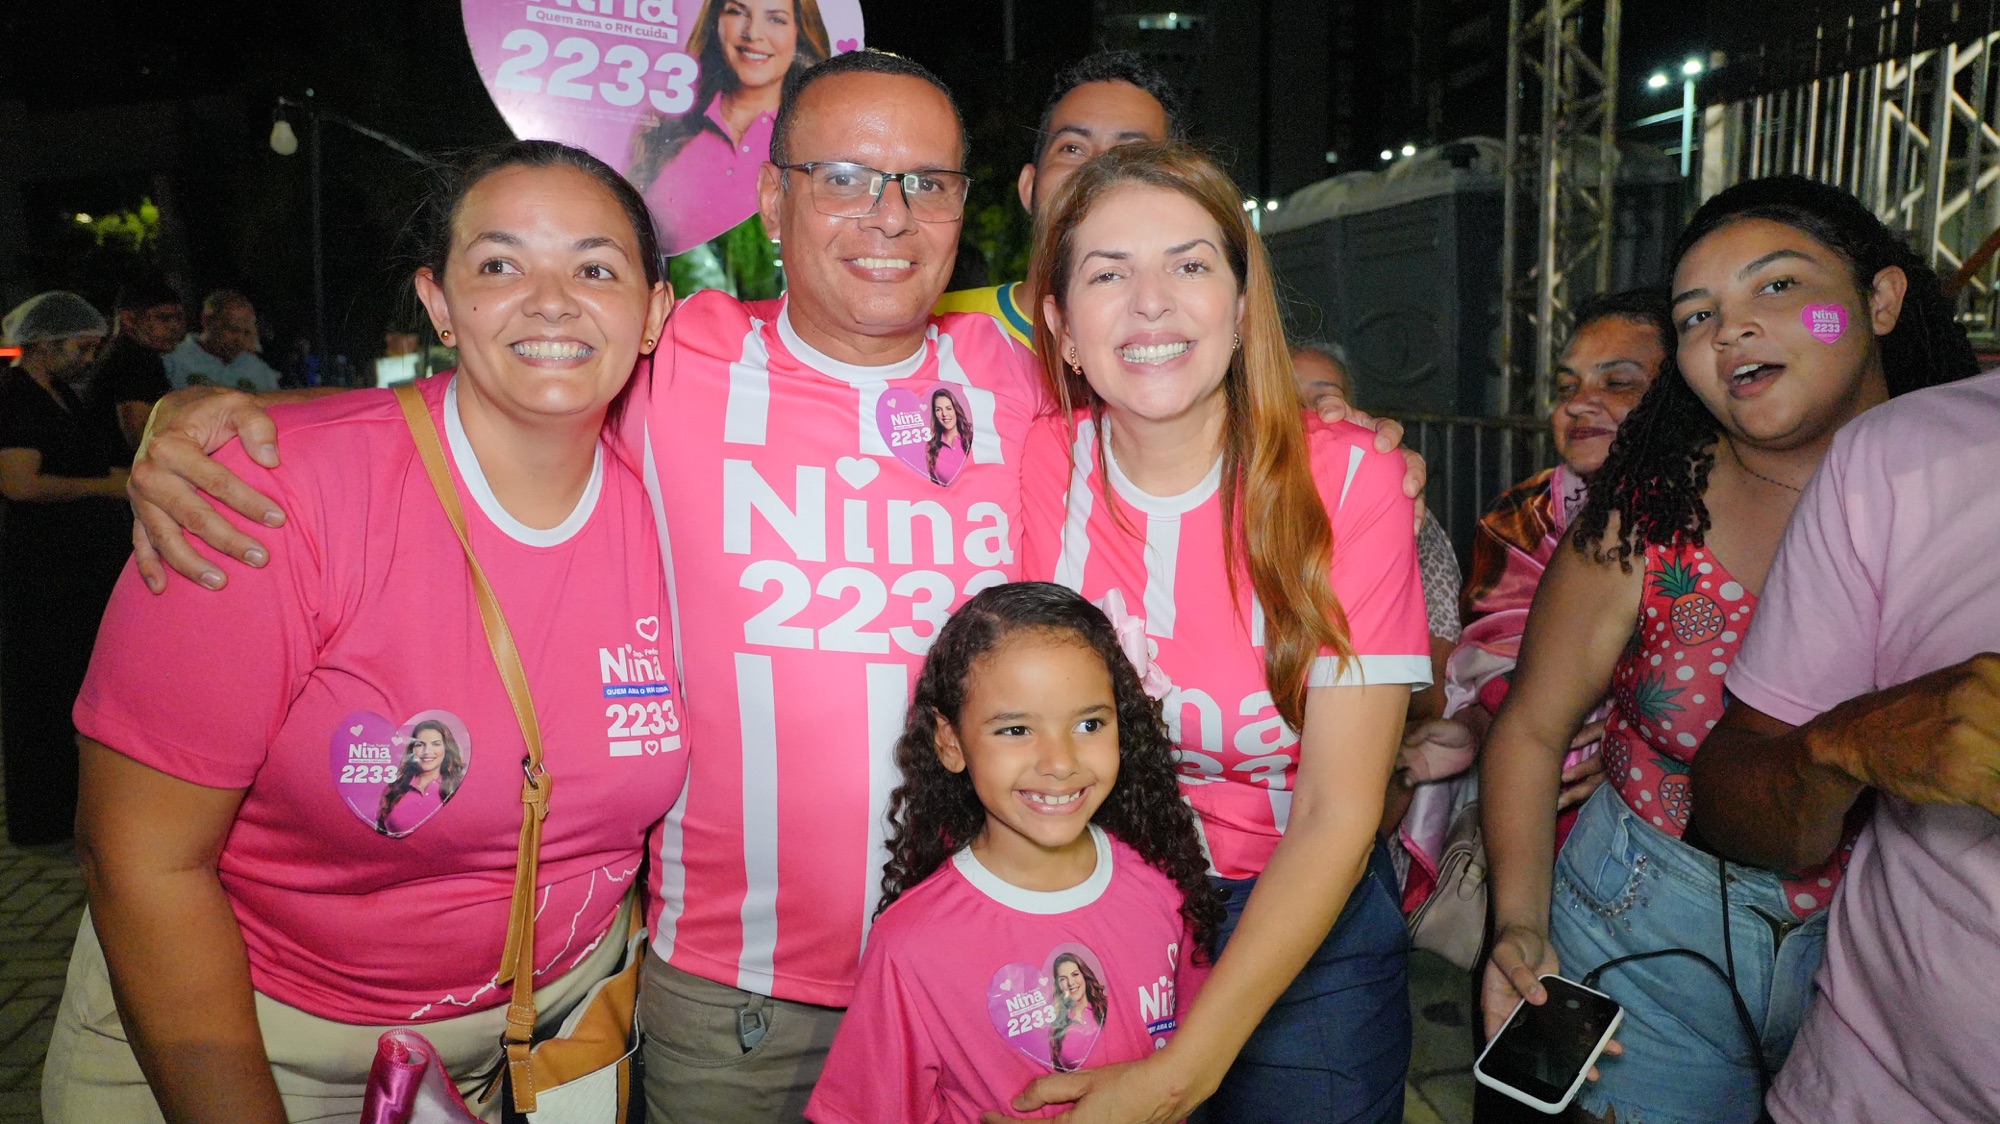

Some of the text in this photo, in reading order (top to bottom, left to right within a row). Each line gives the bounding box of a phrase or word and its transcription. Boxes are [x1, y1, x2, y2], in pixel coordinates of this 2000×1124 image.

[536, 10, 669, 40] Quem ama o RN cuida
[495, 29, 698, 114] 2233
[1812, 310, 1839, 320] Nina
[1813, 323, 1840, 333] 2233
[891, 412, 924, 426] Nina
[891, 427, 932, 447] 2233
[723, 457, 1014, 567] Nina
[738, 559, 1009, 656] 223
[599, 643, 666, 683] Nina
[605, 700, 679, 738] 2233
[1159, 685, 1300, 756] na
[349, 742, 391, 758] Nina
[340, 765, 398, 783] 2233
[1006, 990, 1045, 1012] Nina
[1138, 976, 1175, 1023] Ni
[1007, 1005, 1056, 1037] 2233
